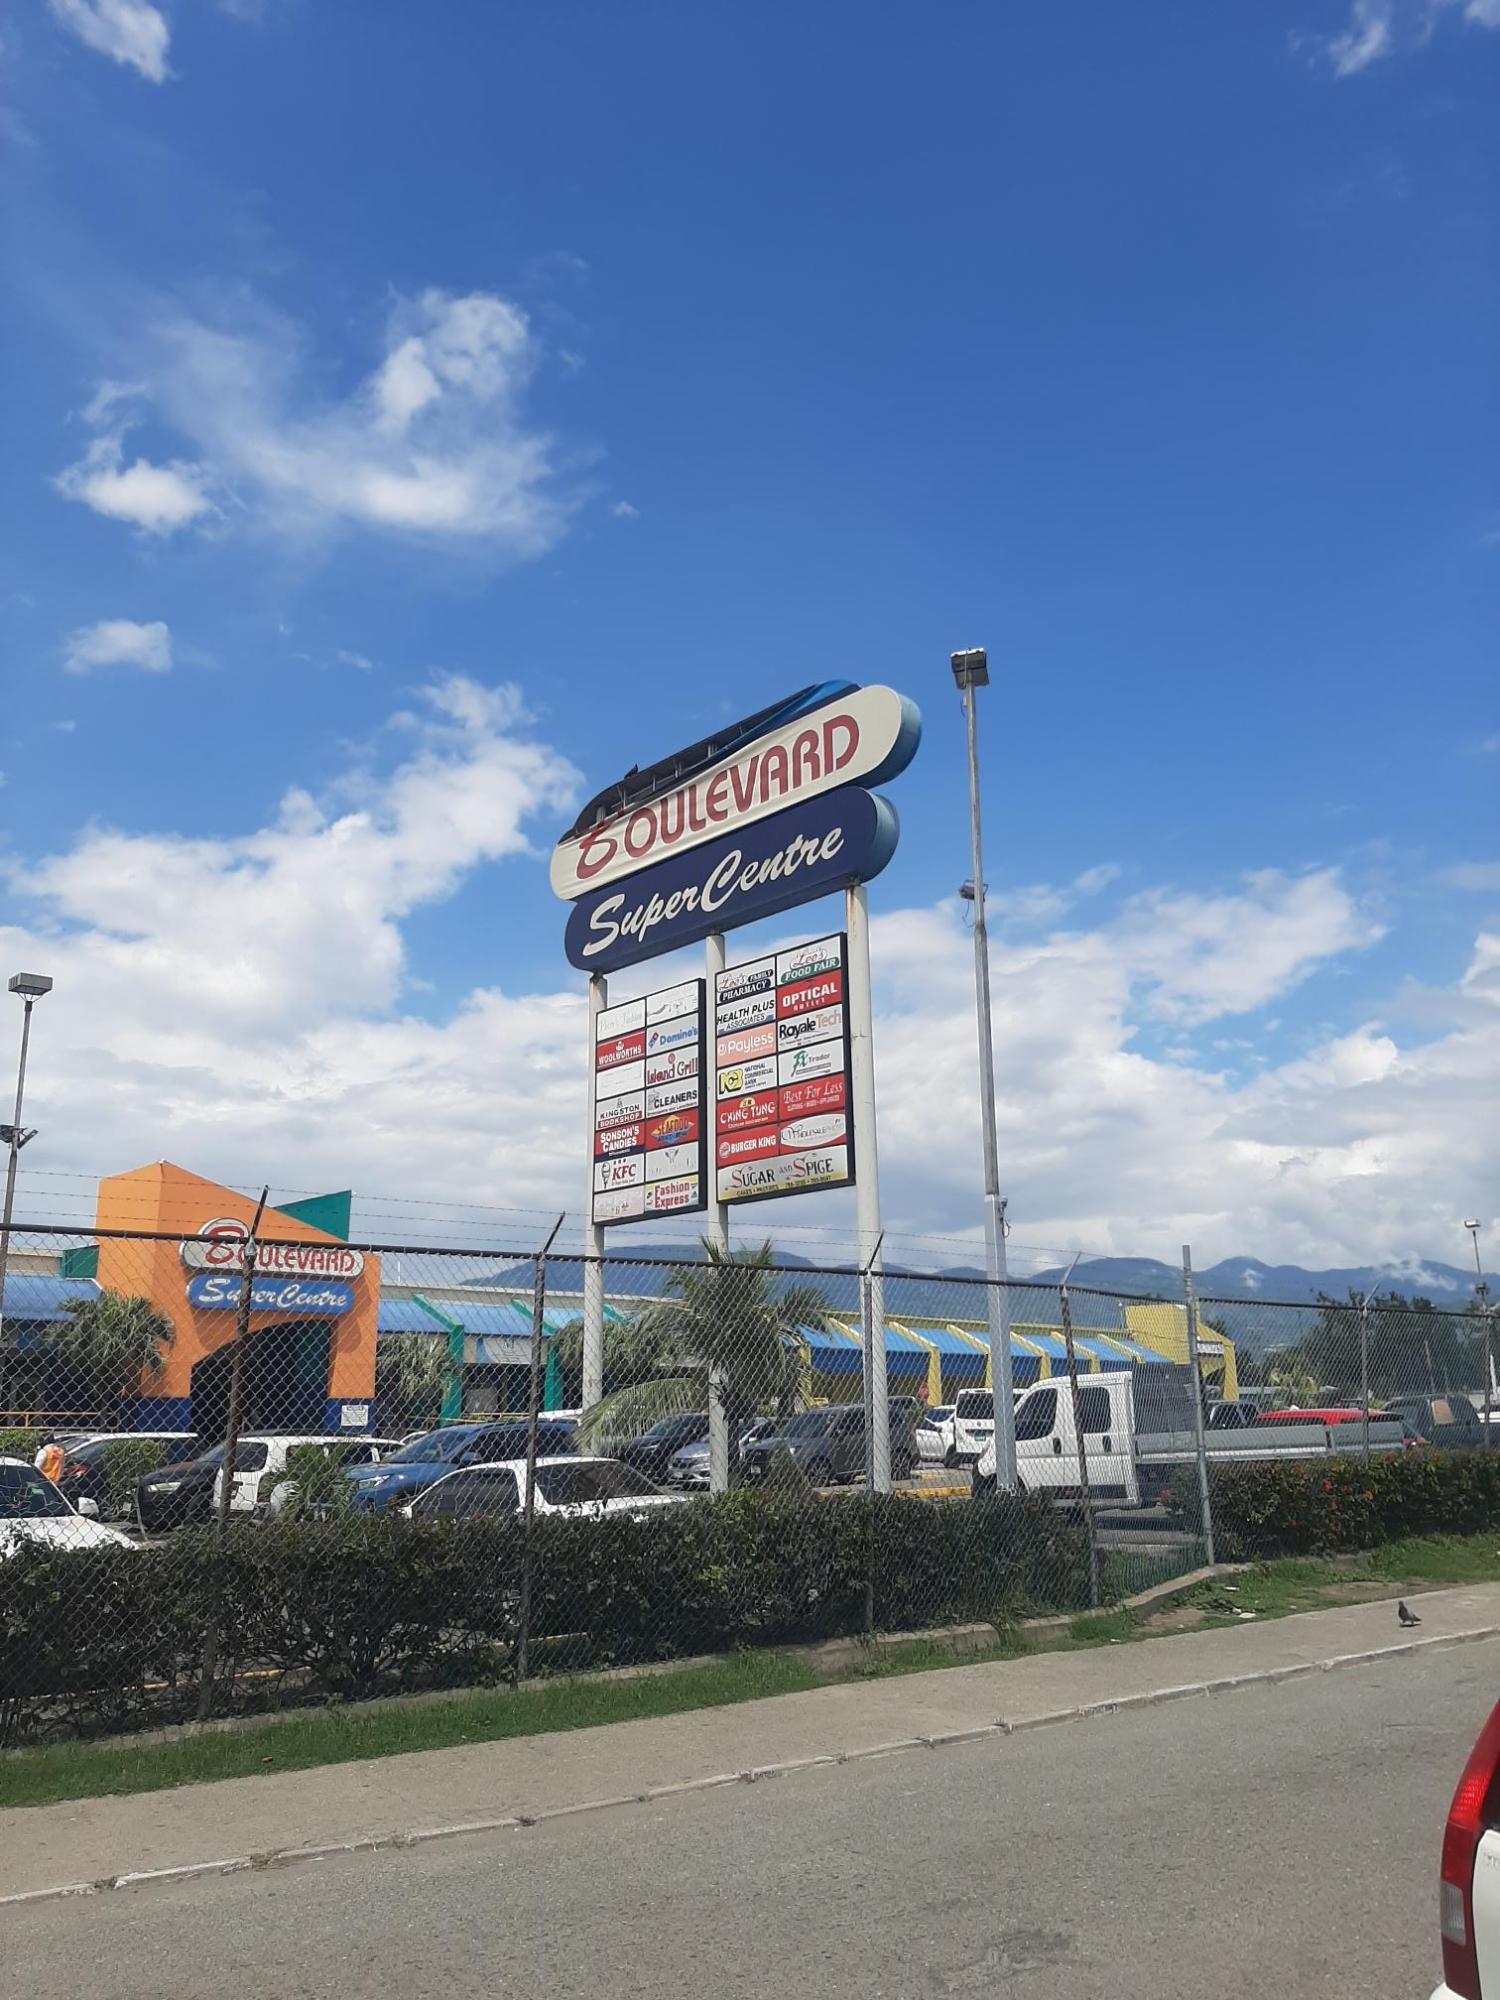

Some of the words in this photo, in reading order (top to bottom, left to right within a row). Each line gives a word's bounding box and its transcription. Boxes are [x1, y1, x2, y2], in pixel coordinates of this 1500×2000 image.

[575, 714, 860, 880] BOULEVARD
[750, 969, 773, 982] FAMILY
[785, 965, 812, 981] FOOD
[814, 957, 838, 972] FAIR
[722, 980, 768, 1001] PHARMACY
[782, 981, 839, 1008] OPTICAL
[716, 1006, 750, 1026] HEALTH
[751, 999, 775, 1015] PLUS
[726, 1013, 766, 1031] ASSOCIATES
[660, 1026, 698, 1046] Domino's
[727, 1032, 775, 1055] Payless
[598, 1044, 642, 1065] WOOLWORTHS
[647, 1063, 675, 1085] Island
[677, 1057, 698, 1076] Grill
[653, 1089, 698, 1108] CLEANERS
[600, 1103, 640, 1119] KINGSTON
[600, 1112, 641, 1128] BOOKSHOP
[720, 1108, 749, 1124] CHING
[750, 1101, 776, 1118] TUNG
[600, 1124, 640, 1144] SONSON'S
[602, 1136, 638, 1153] CANDIES
[730, 1138, 757, 1154] BURGER
[758, 1135, 777, 1149] KING
[612, 1163, 637, 1181] KFC
[730, 1166, 776, 1188] SUGAR
[655, 1181, 690, 1197] Fashion
[655, 1194, 690, 1210] Express
